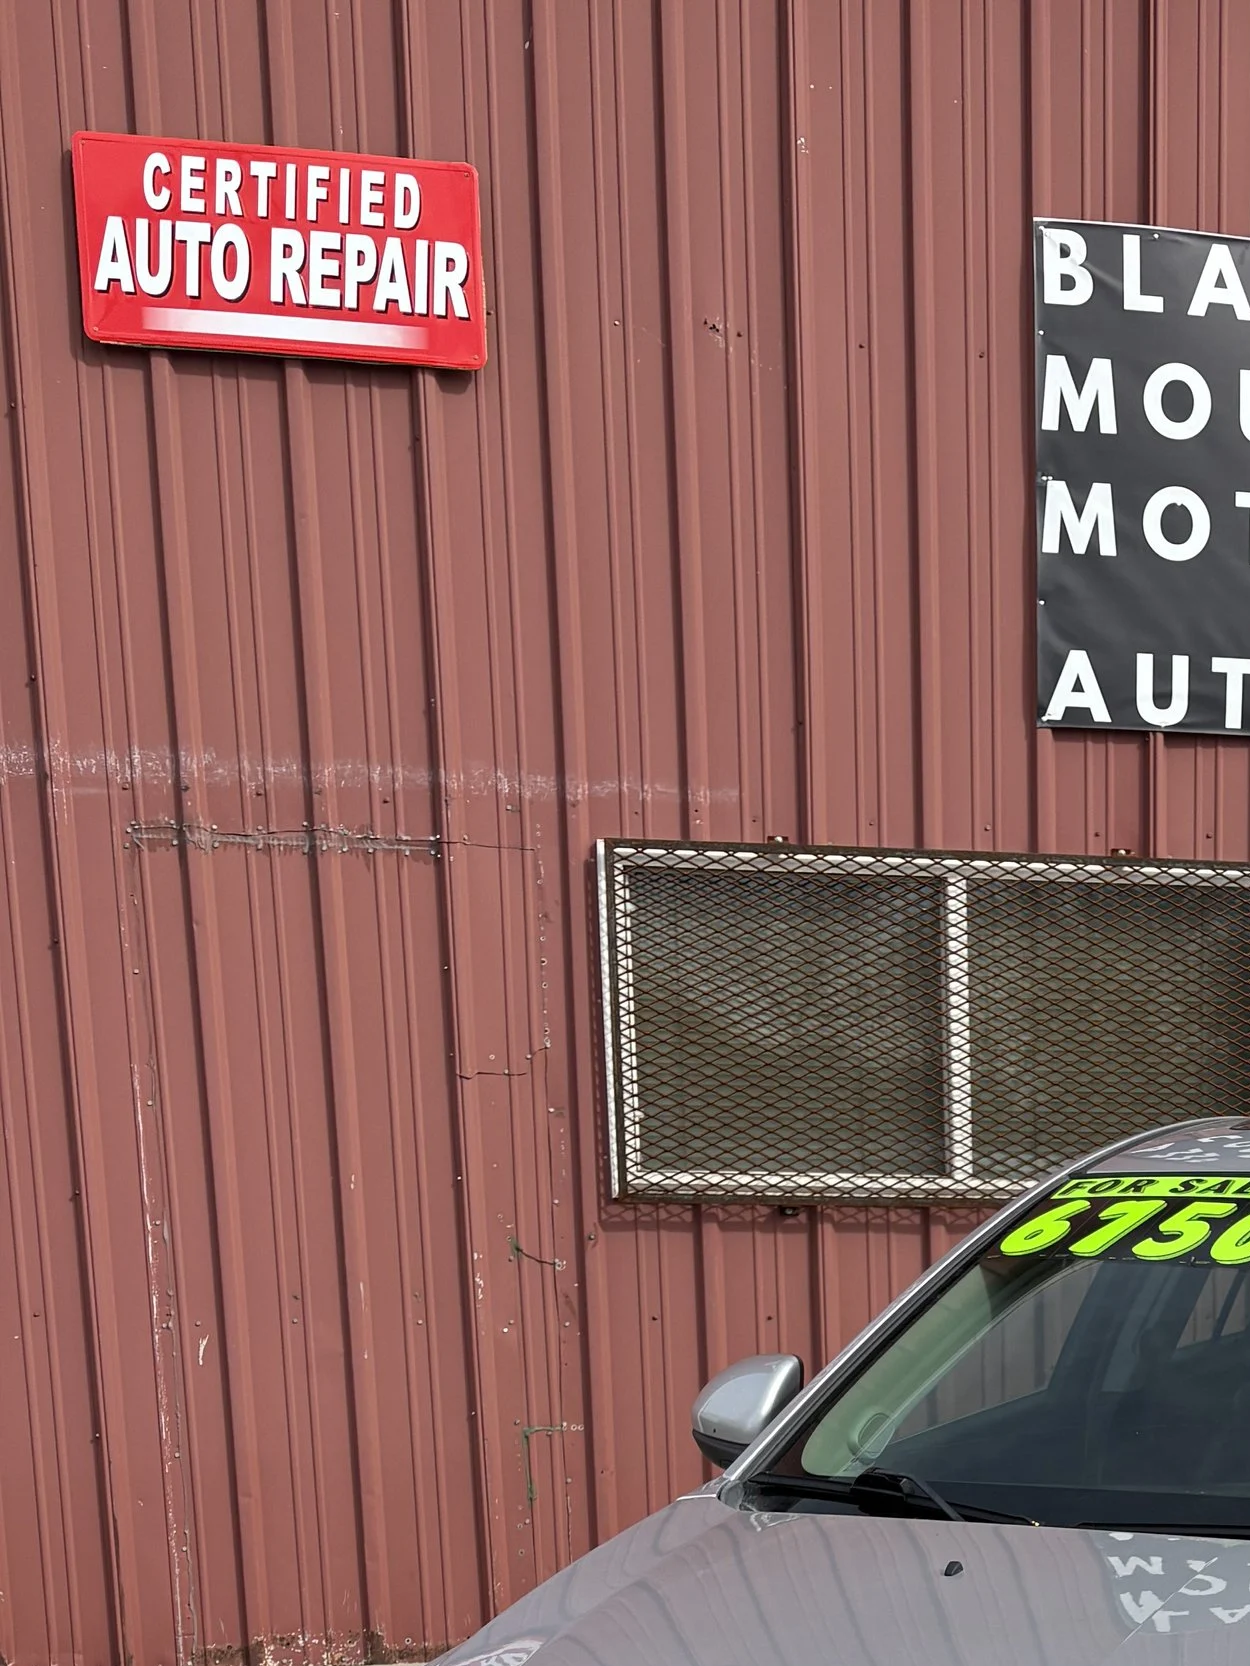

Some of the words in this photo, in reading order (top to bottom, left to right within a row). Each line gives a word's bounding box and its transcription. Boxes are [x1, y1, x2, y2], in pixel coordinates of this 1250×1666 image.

[143, 152, 421, 229] CERTIFIED
[94, 216, 250, 301] AUTO
[270, 227, 469, 318] REPAIR
[1062, 1179, 1158, 1197] FOR
